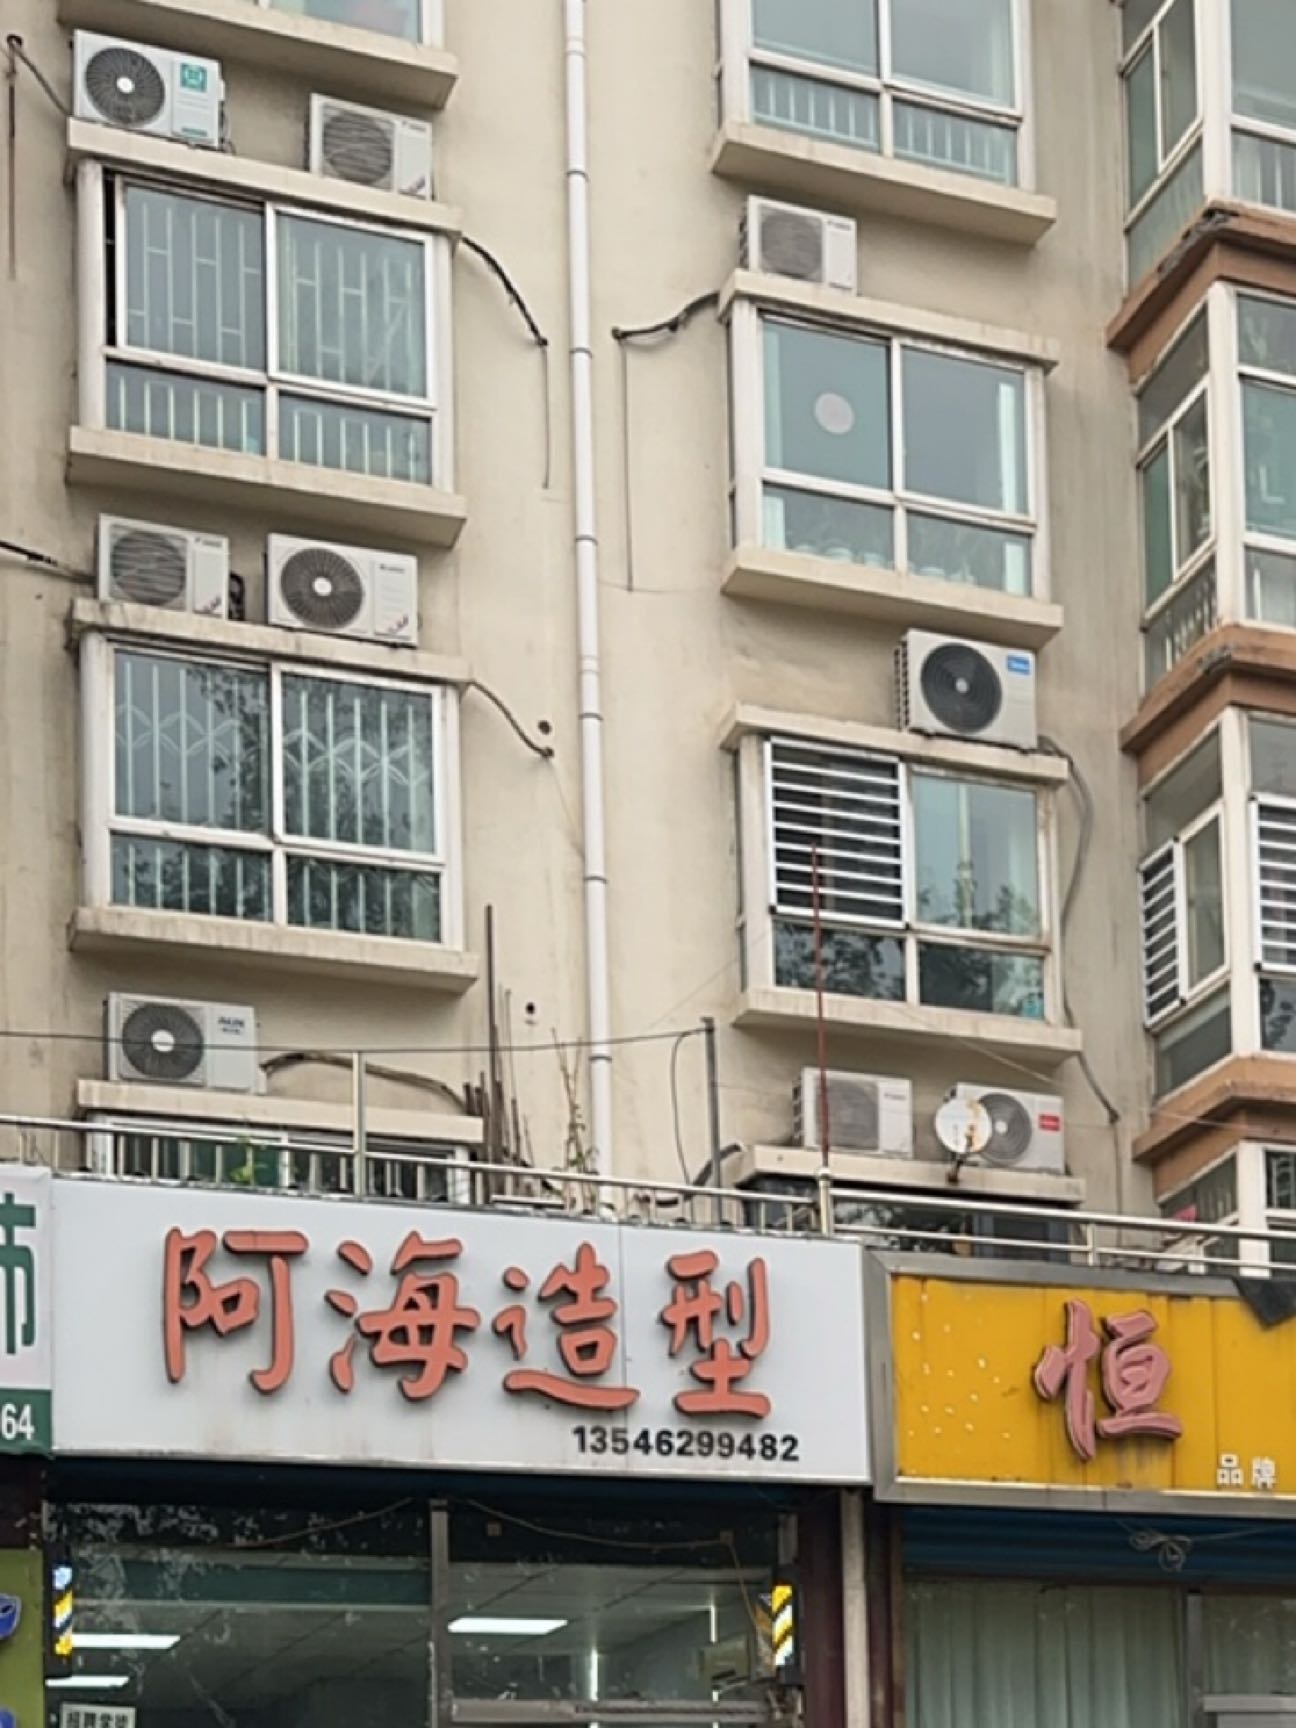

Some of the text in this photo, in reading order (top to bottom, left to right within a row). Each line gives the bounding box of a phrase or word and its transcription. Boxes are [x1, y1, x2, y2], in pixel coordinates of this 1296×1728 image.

[163, 1226, 773, 1420] 阿海造型
[572, 1426, 800, 1463] 13546299482
[1216, 1453, 1277, 1490] 品牌
